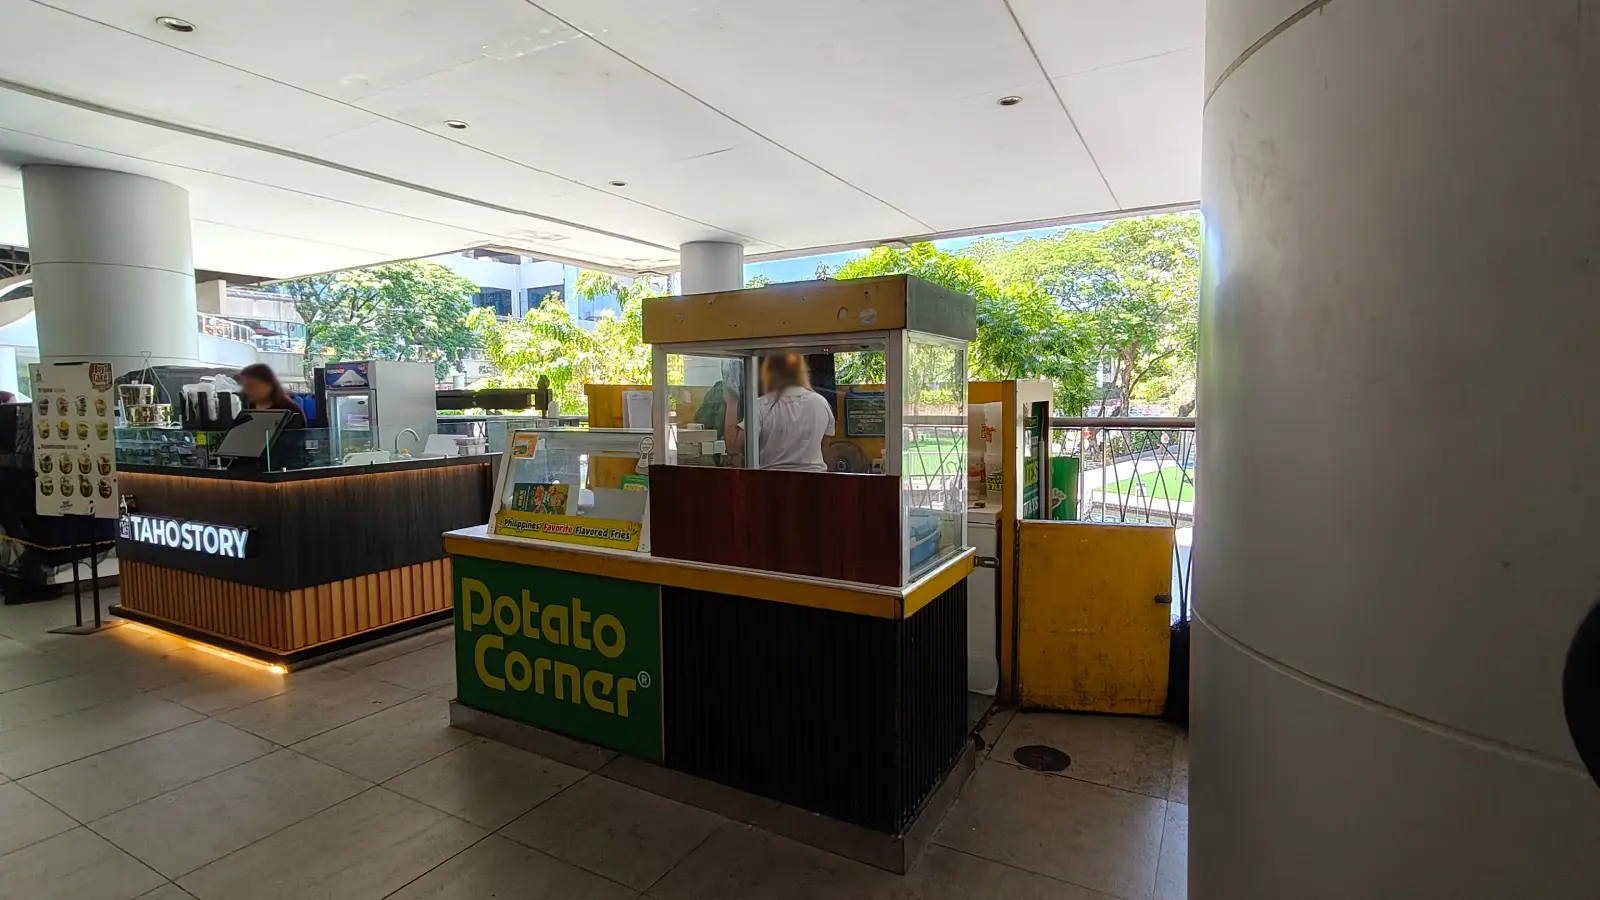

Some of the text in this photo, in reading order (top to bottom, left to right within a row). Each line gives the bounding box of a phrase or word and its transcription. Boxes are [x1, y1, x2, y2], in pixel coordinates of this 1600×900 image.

[504, 517, 631, 541] Philippines' Favorite Flavored Fries
[461, 576, 626, 658] Potato
